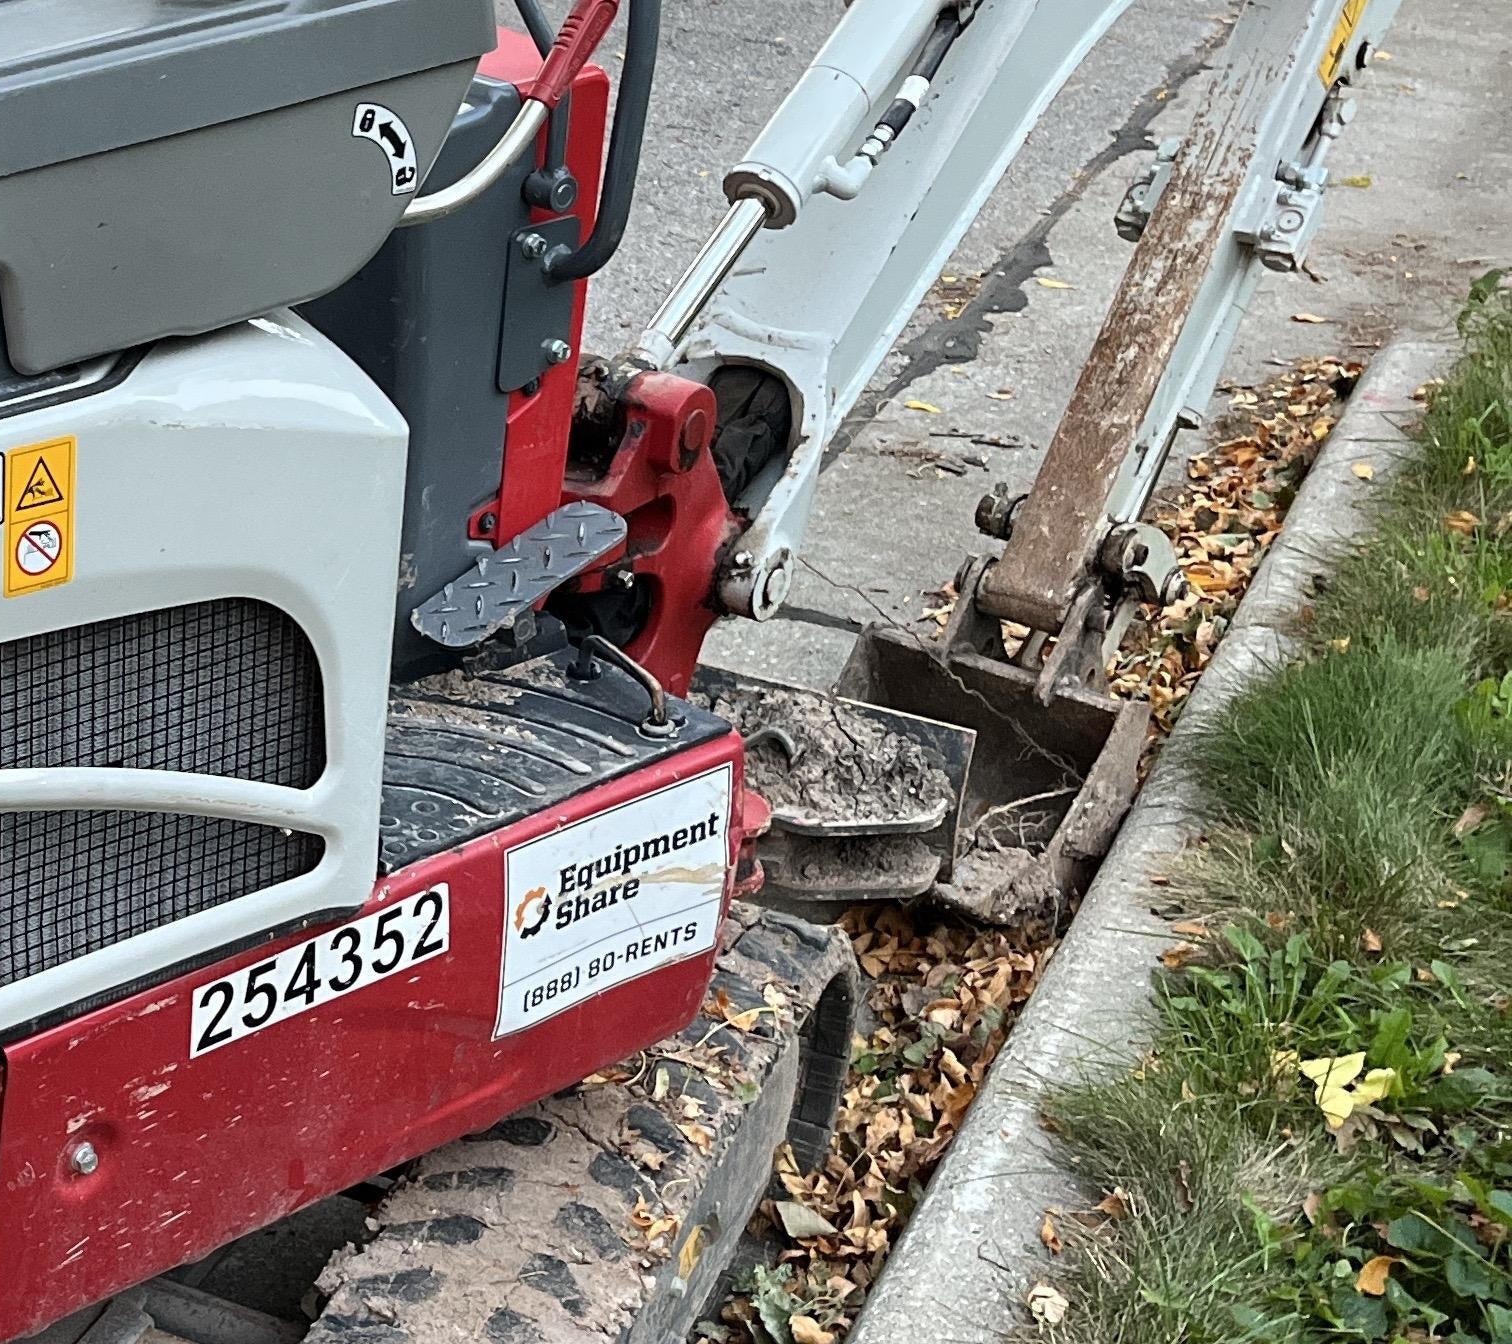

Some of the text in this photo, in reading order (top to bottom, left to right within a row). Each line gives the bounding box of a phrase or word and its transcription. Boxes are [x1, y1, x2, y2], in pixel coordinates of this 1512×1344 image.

[558, 811, 720, 897] Equipment
[554, 878, 640, 931] Share
[196, 890, 444, 1053] 254352
[522, 921, 698, 1013] (888) 80-RENTS
